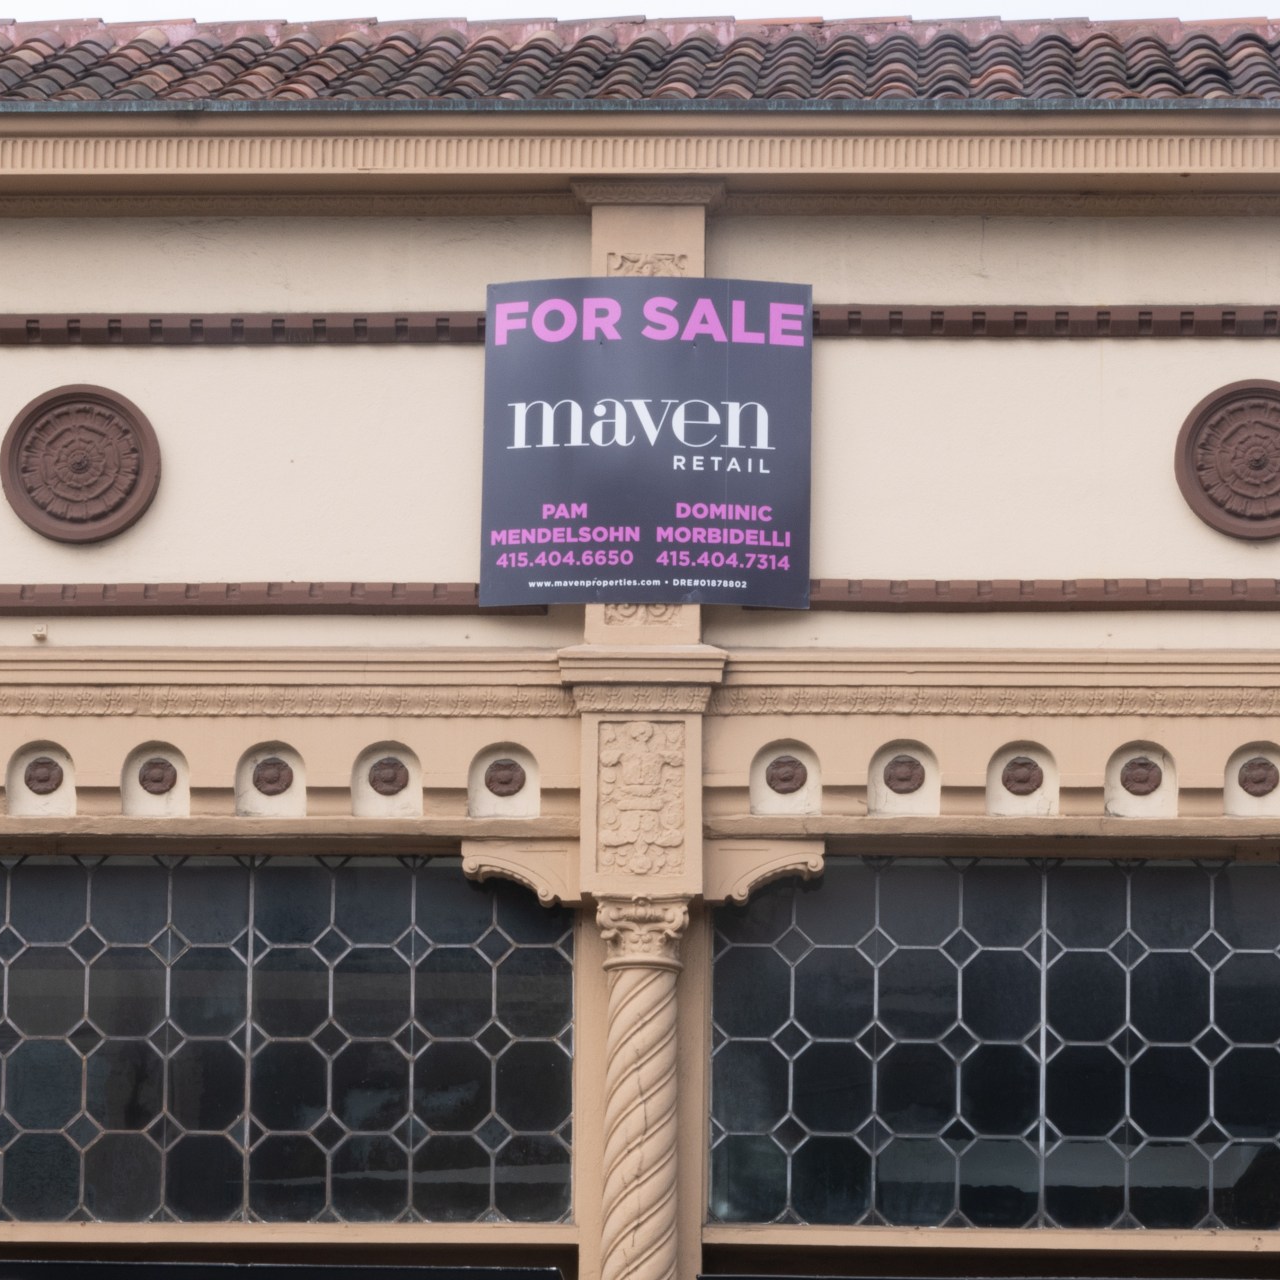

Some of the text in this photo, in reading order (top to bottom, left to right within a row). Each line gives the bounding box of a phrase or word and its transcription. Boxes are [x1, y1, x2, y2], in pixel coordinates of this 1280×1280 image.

[495, 296, 805, 347] FOR SALE
[506, 398, 776, 449] maven
[673, 455, 771, 474] RETAIL
[542, 503, 588, 519] PAM
[676, 502, 773, 521] DOMINIC
[491, 526, 640, 546] MENDELSOHN
[656, 526, 791, 547] MORBIDELLI
[496, 549, 634, 568] 415.404.6650
[656, 551, 790, 571] 415.404.7314
[528, 578, 661, 588] www.mavenproperties.com
